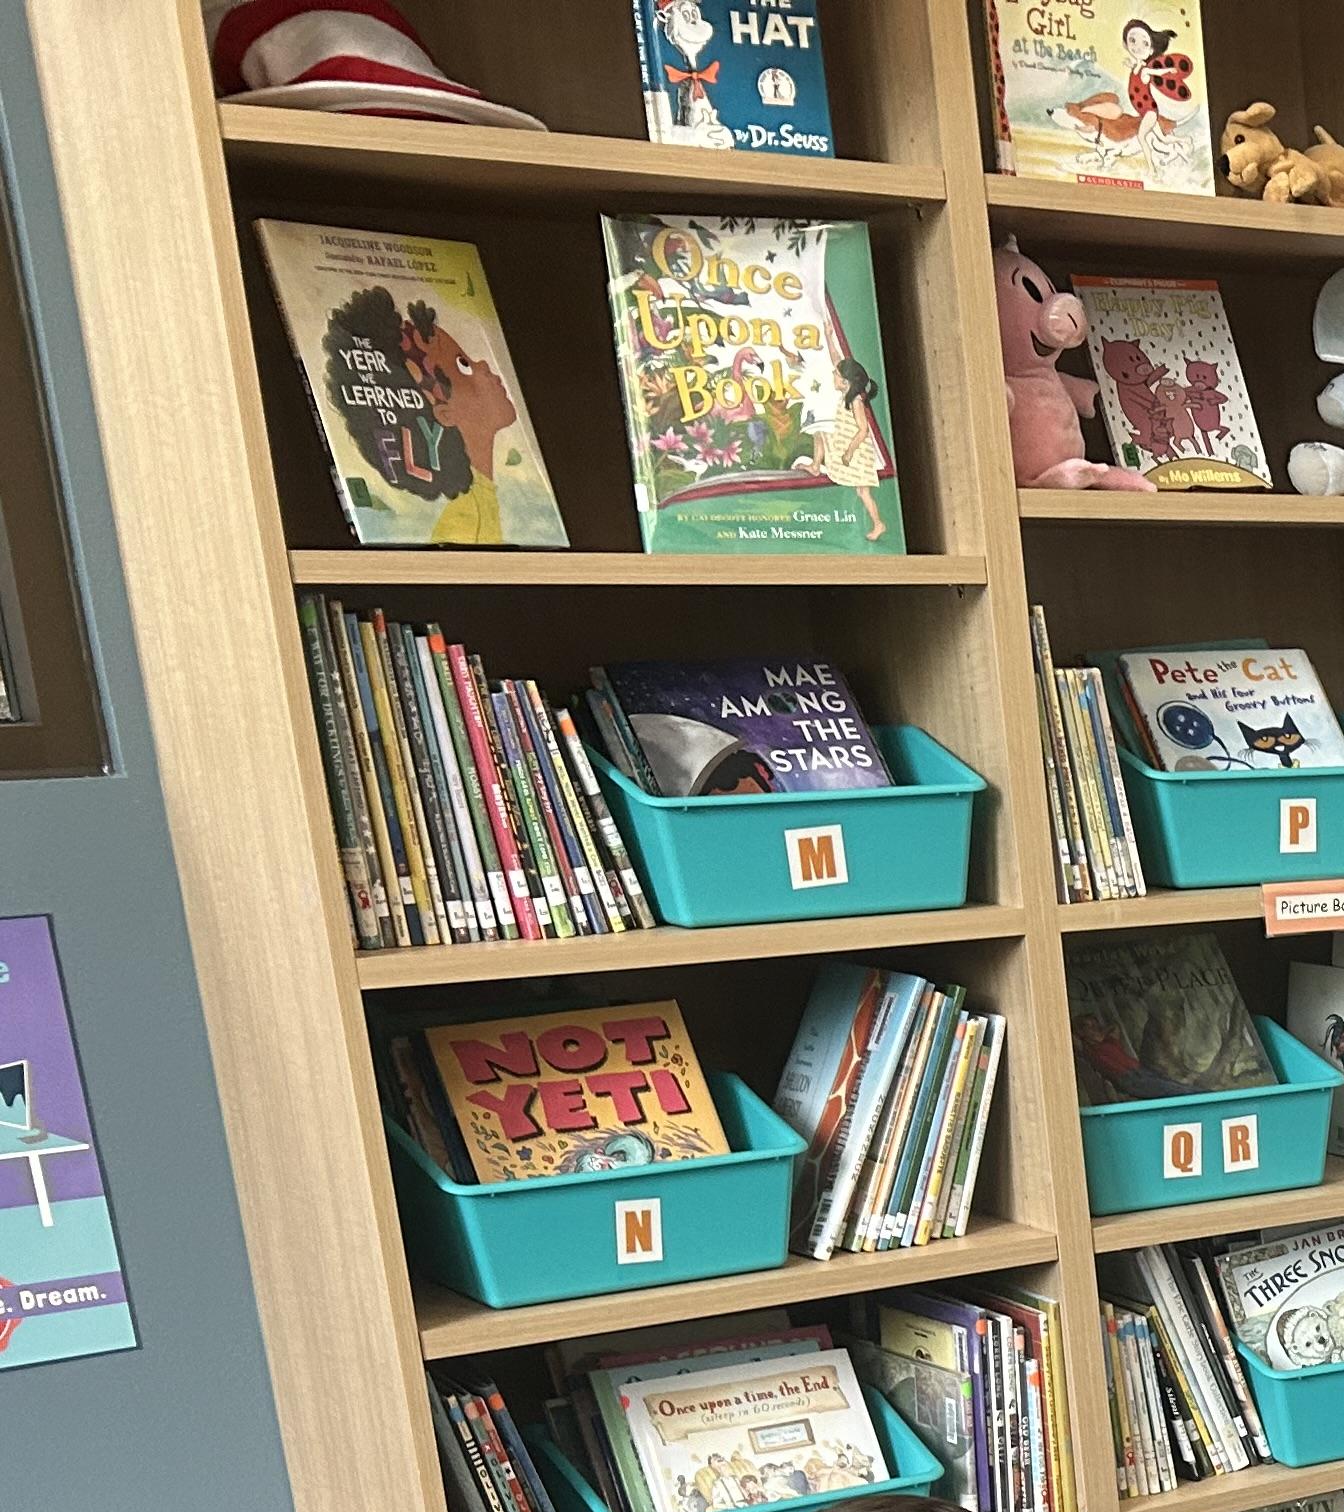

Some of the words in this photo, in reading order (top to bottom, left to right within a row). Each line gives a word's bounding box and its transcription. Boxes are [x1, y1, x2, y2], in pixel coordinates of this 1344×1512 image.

[730, 11, 815, 48] HAT
[1056, 42, 1097, 62] Beach
[749, 125, 778, 148] Dr.
[780, 124, 828, 152] Seuss
[320, 235, 380, 251] JACQUELINE
[383, 242, 432, 257] WOODSON
[366, 256, 405, 268] RAFAEL
[652, 227, 803, 300] Once
[1169, 295, 1212, 319] Pig
[632, 290, 782, 357] Upon
[792, 323, 823, 350] a
[352, 336, 371, 348] THE
[339, 349, 391, 374] YEAR
[358, 372, 376, 384] WE
[341, 385, 424, 409] LEARNED
[669, 360, 805, 423] Book
[377, 408, 397, 426] TO
[374, 415, 444, 484] FLY
[1169, 470, 1190, 482] Mo
[1191, 470, 1241, 482] Willems
[792, 510, 831, 523] Grace
[834, 510, 857, 523] Lin
[738, 527, 767, 539] Kate
[771, 528, 823, 539] Messner
[762, 664, 836, 690] MAE
[1150, 658, 1218, 685] Pete
[1218, 660, 1238, 673] the
[1241, 658, 1297, 682] Cat
[1225, 697, 1266, 712] Groovy
[1270, 694, 1316, 708] Buttons
[794, 718, 861, 742] THE
[769, 747, 873, 774] STARS
[1289, 806, 1310, 845] P
[798, 835, 836, 881] M
[1280, 898, 1329, 914] Picture
[460, 1016, 672, 1086] NOT
[467, 1068, 691, 1143] YETI
[1171, 1130, 1193, 1172] Q
[1229, 1125, 1251, 1162] R
[625, 1209, 652, 1254] N
[1293, 1235, 1321, 1252] JAN
[1244, 1267, 1259, 1282] THE
[1244, 1259, 1308, 1308] THREE
[19, 1285, 107, 1312] Dream.
[658, 1399, 696, 1417] Once
[701, 1397, 732, 1413] upon
[734, 1396, 742, 1405] a
[744, 1388, 778, 1403] time,
[779, 1381, 800, 1397] the
[801, 1375, 830, 1393] End
[753, 1403, 770, 1414] 60
[1020, 1415, 1030, 1436] OLD
